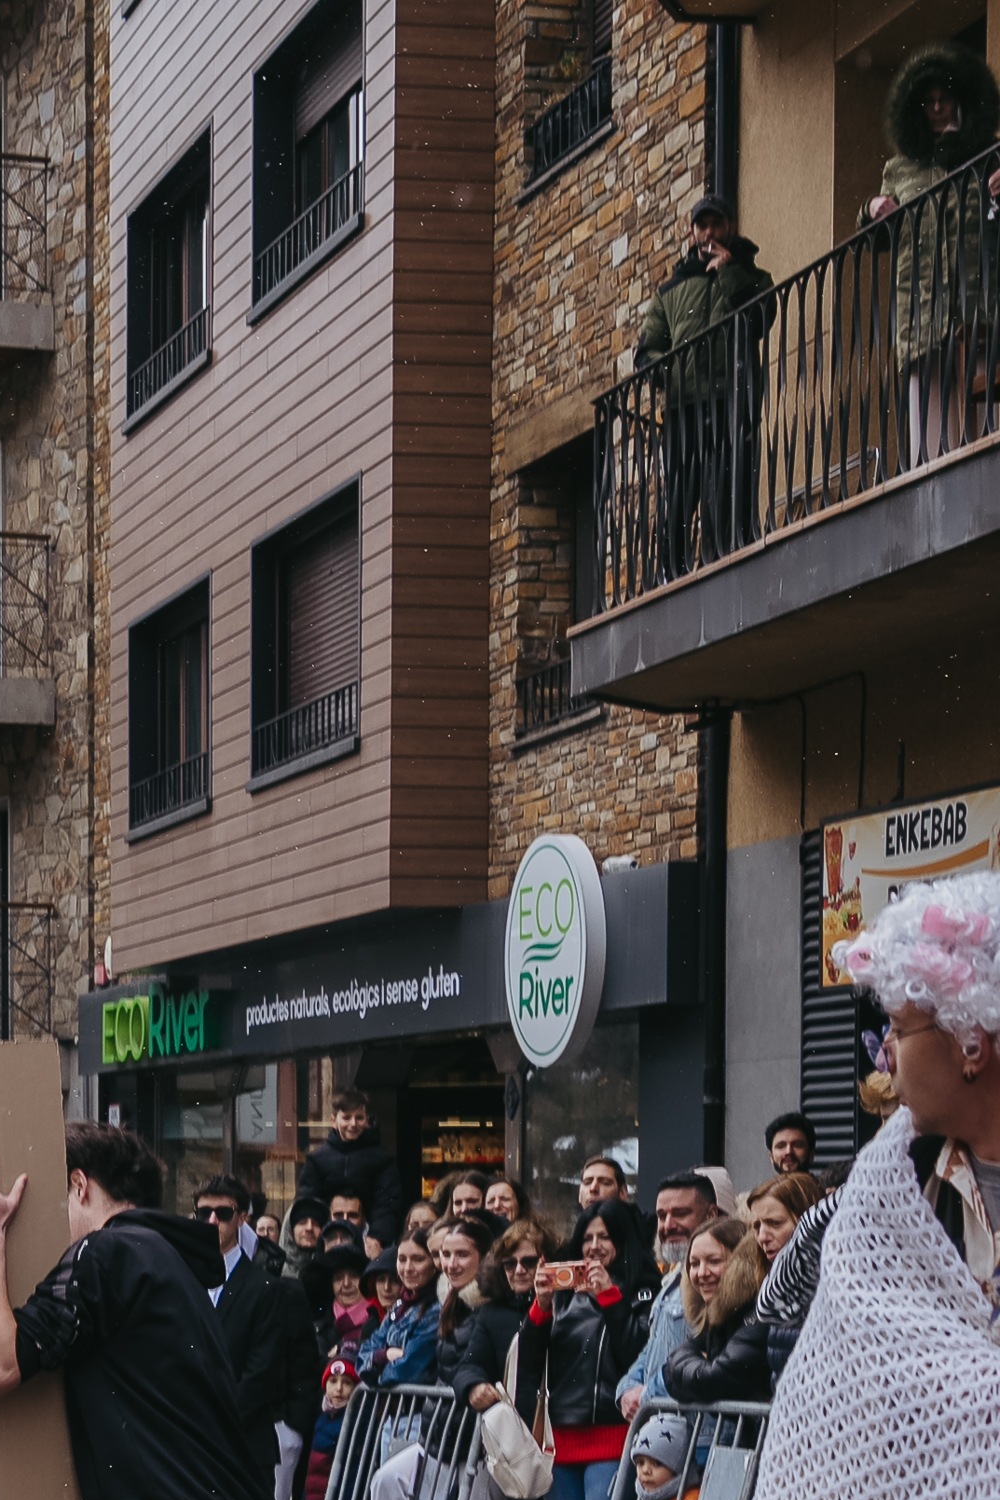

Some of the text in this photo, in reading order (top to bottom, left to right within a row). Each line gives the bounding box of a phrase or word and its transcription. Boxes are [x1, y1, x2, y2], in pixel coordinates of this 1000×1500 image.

[885, 802, 968, 857] ENKEBAB
[519, 878, 574, 941] ECO
[246, 995, 289, 1036] productes
[290, 986, 331, 1019] naturals,
[332, 978, 379, 1019] ecològics
[386, 978, 418, 1005] sense
[421, 964, 460, 1010] gluten
[519, 966, 574, 1021] River
